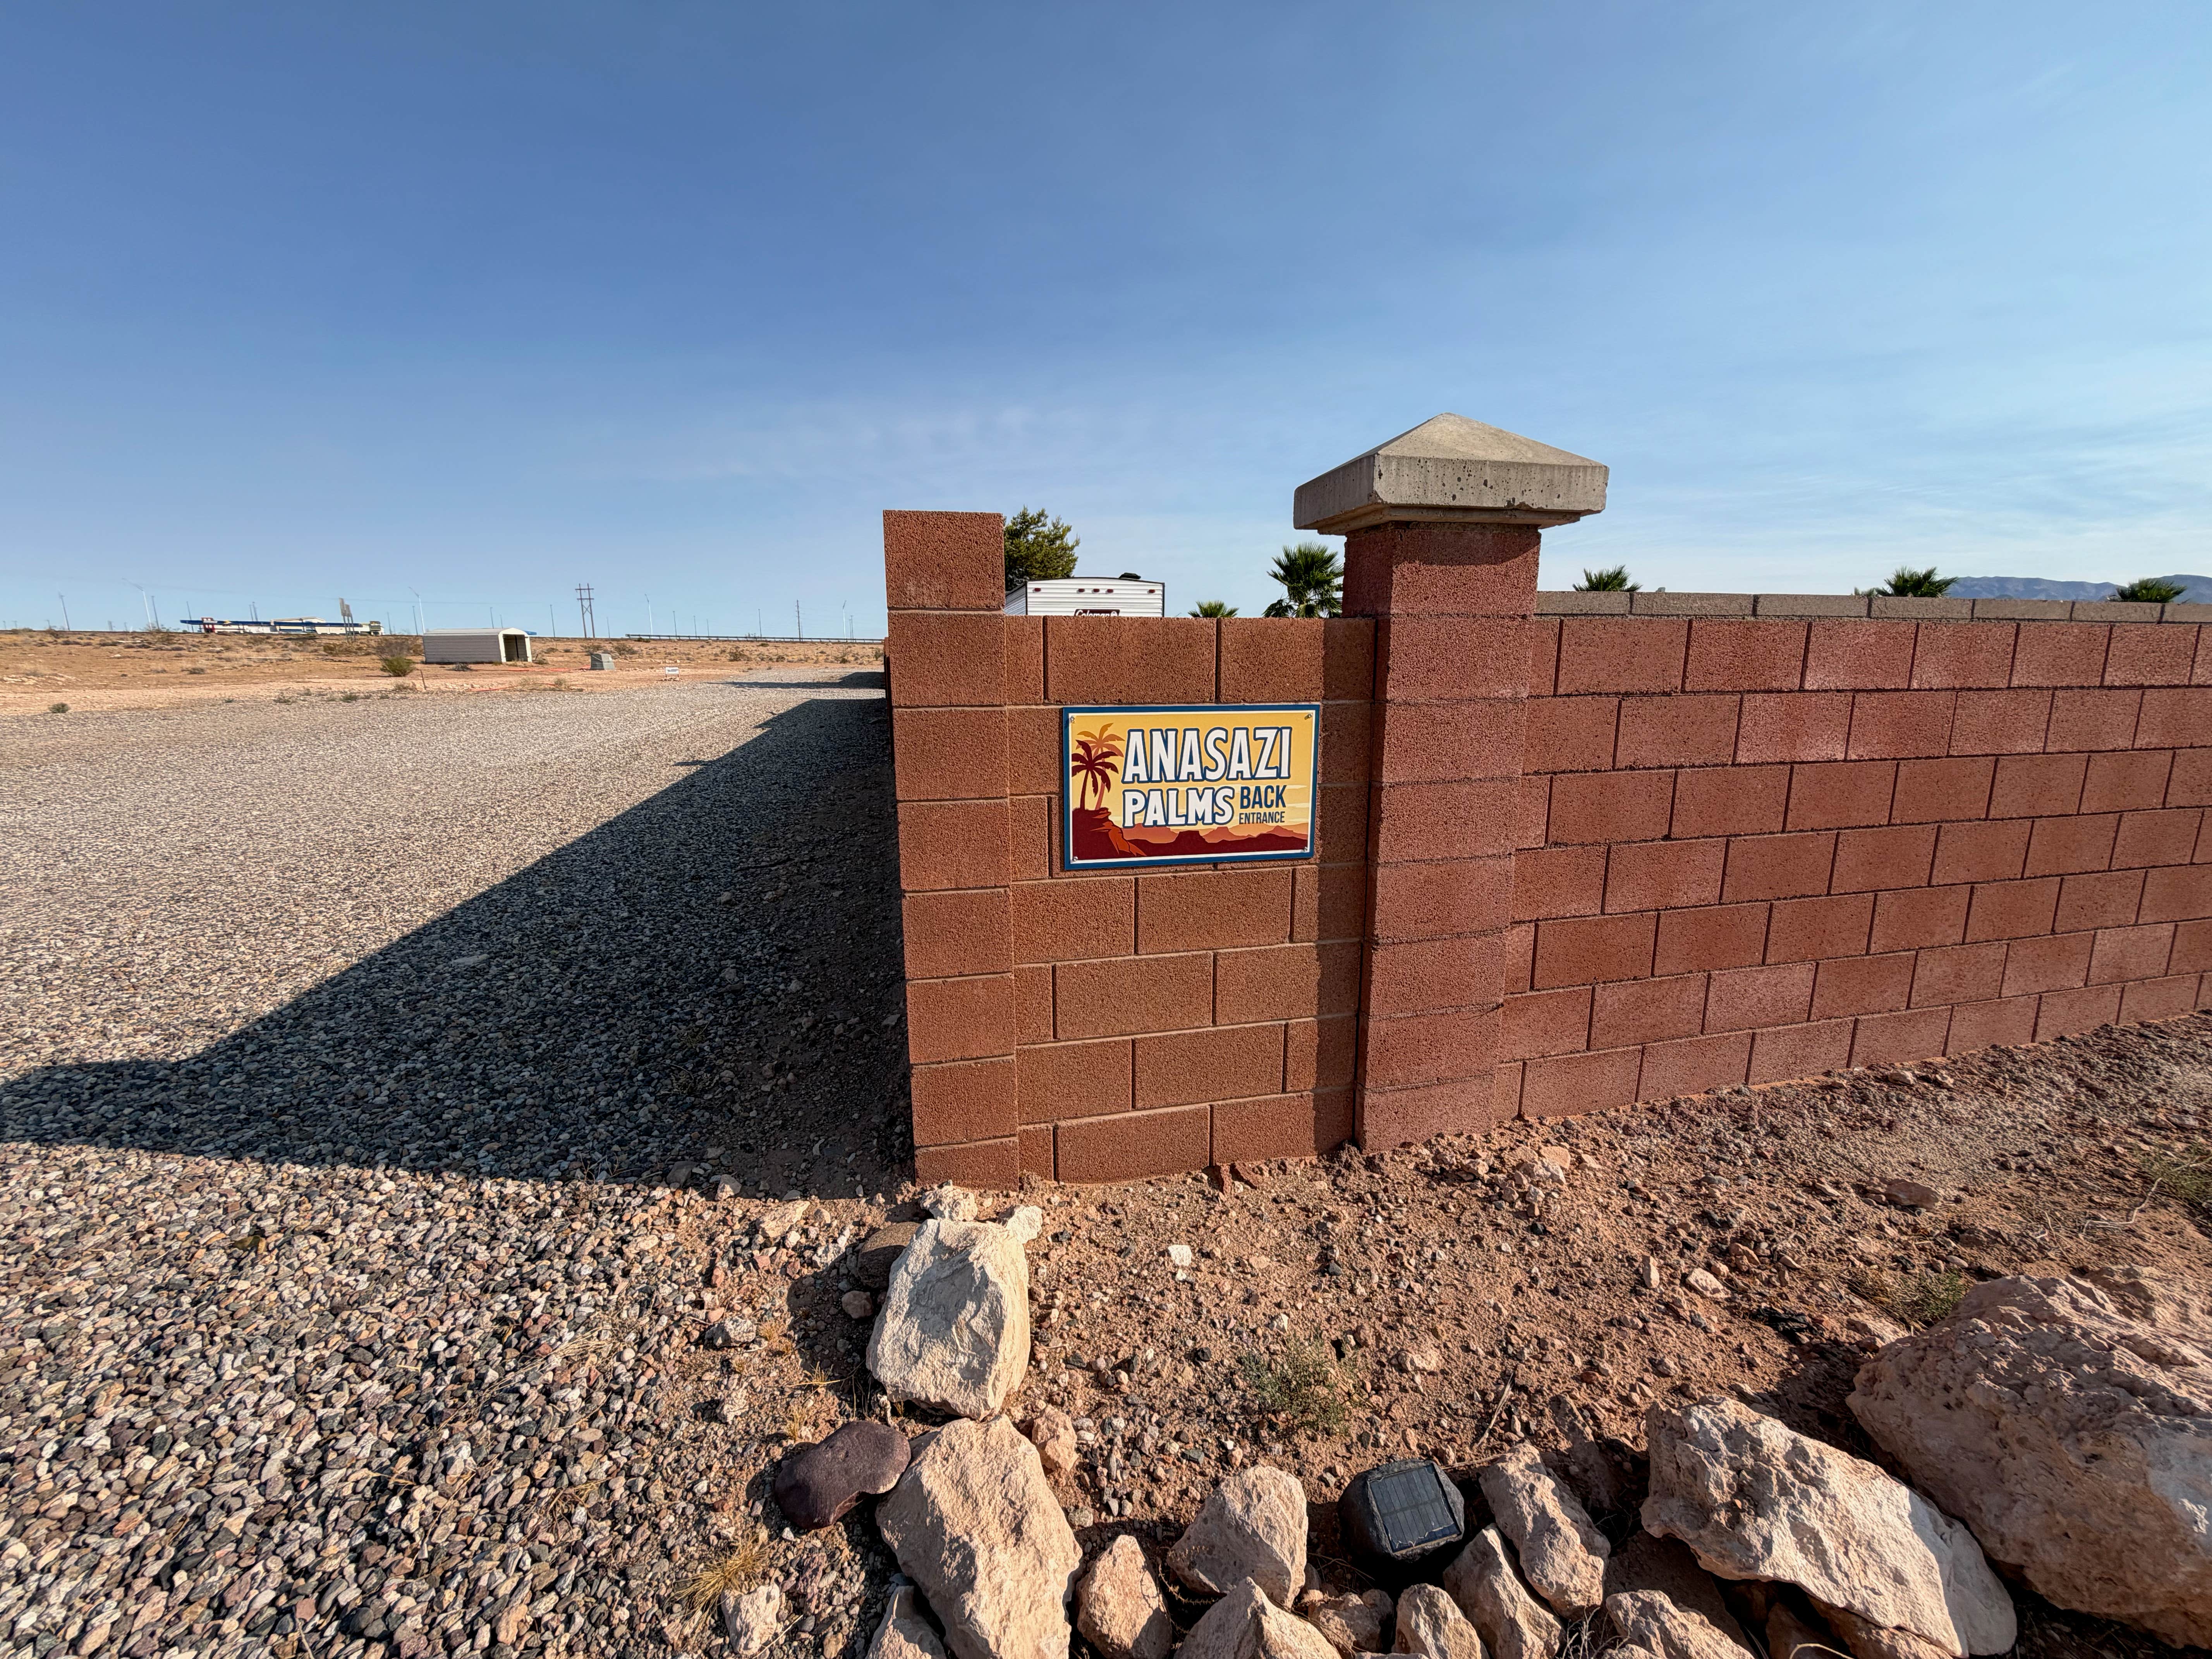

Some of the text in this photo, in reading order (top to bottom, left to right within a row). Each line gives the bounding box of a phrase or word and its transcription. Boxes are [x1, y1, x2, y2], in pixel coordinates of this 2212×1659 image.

[1121, 726, 1292, 783] ANASAZI
[1122, 786, 1235, 828] PALMS
[1240, 785, 1286, 809] BACK
[1239, 811, 1285, 824] ENTRANCE
